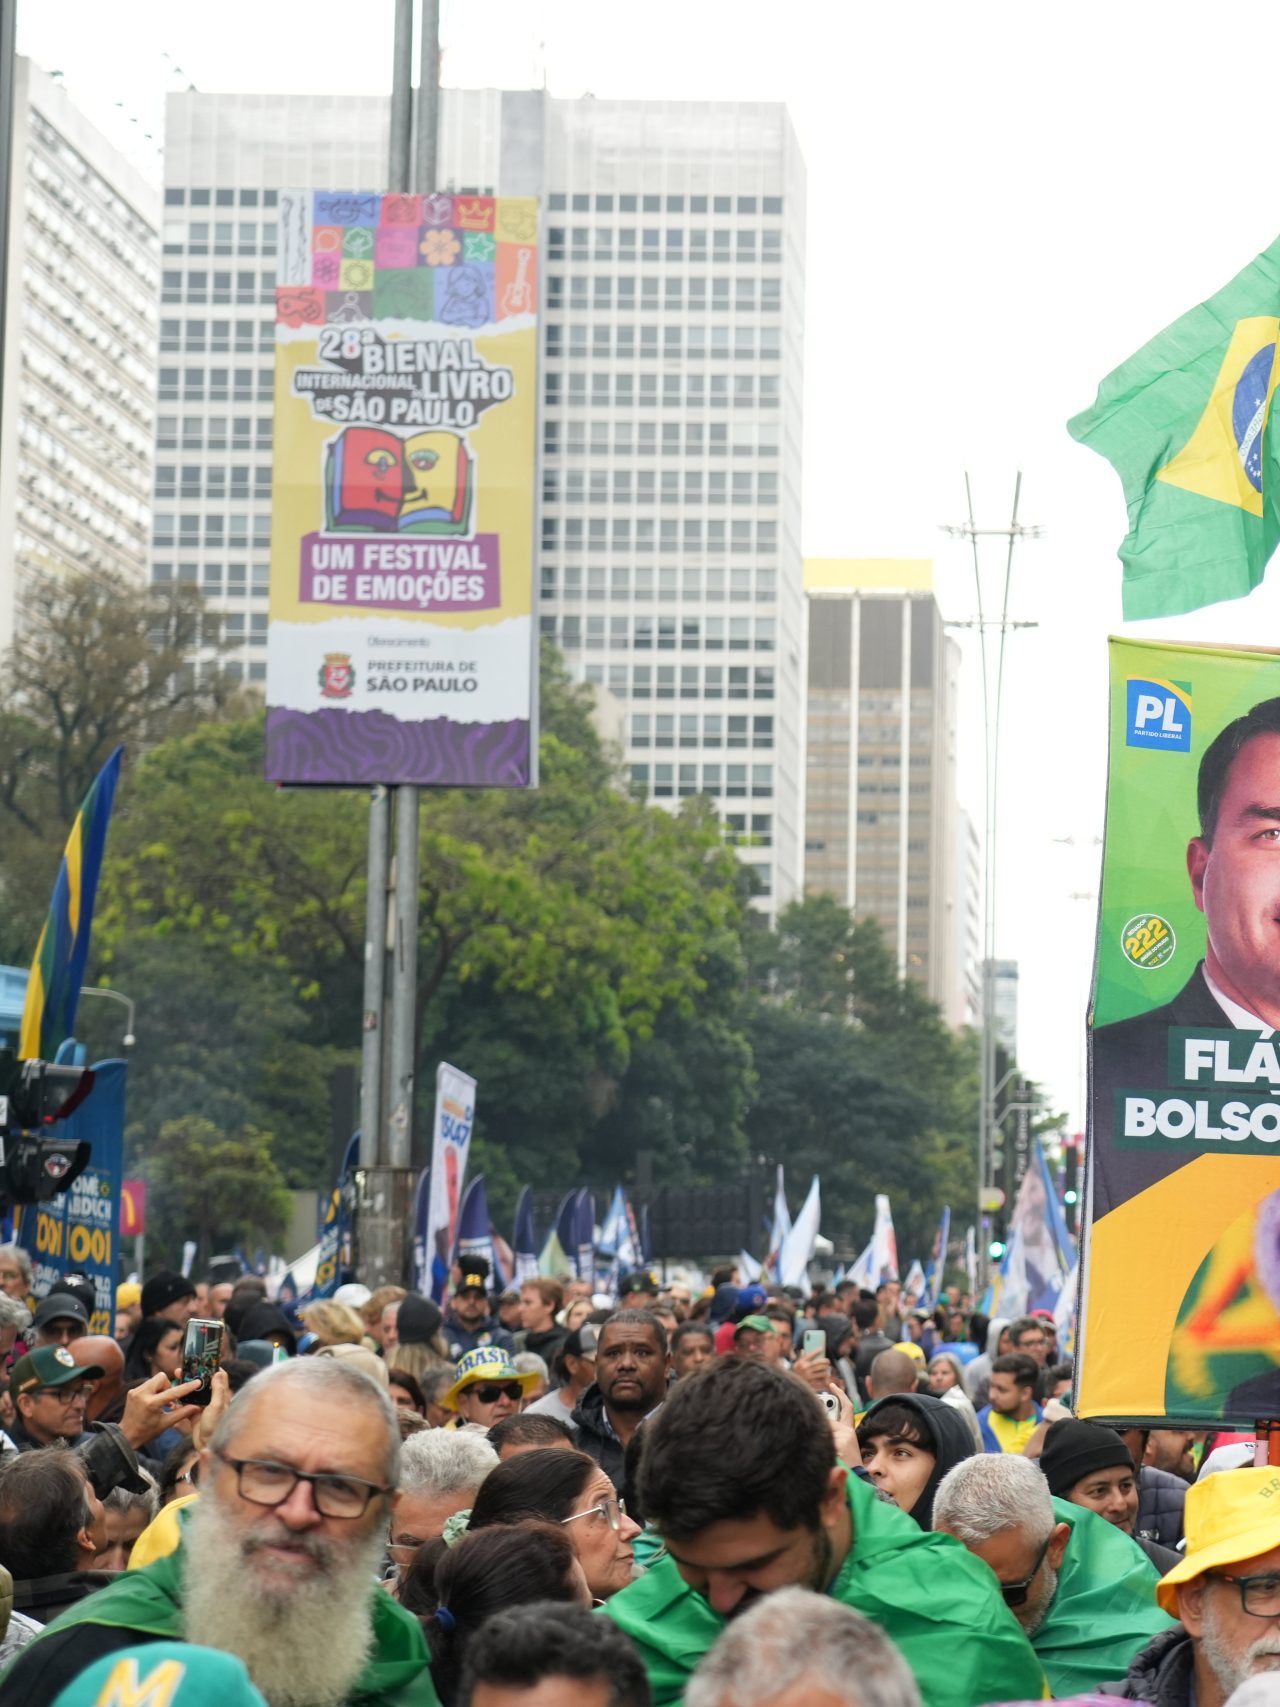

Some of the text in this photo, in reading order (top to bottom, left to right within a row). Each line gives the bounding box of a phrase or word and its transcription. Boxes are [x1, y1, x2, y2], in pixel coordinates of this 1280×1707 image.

[320, 328, 375, 360] 28ª
[362, 339, 482, 373] BIENAL
[296, 372, 416, 390] INTERNACIONAL
[421, 370, 512, 400] LIVRO
[315, 390, 474, 426] DE SÃO PAULO
[311, 543, 487, 570] UM FESTIVAL
[311, 571, 485, 609] DE EMOÇÕES
[367, 660, 477, 673] PREFEITURA DE
[366, 674, 479, 693] SÃO PAULO
[1134, 694, 1183, 733] PL
[1134, 729, 1182, 740] PARTIDO LIBERAL
[1125, 918, 1168, 960] 222
[71, 1172, 99, 1198] OMÉ
